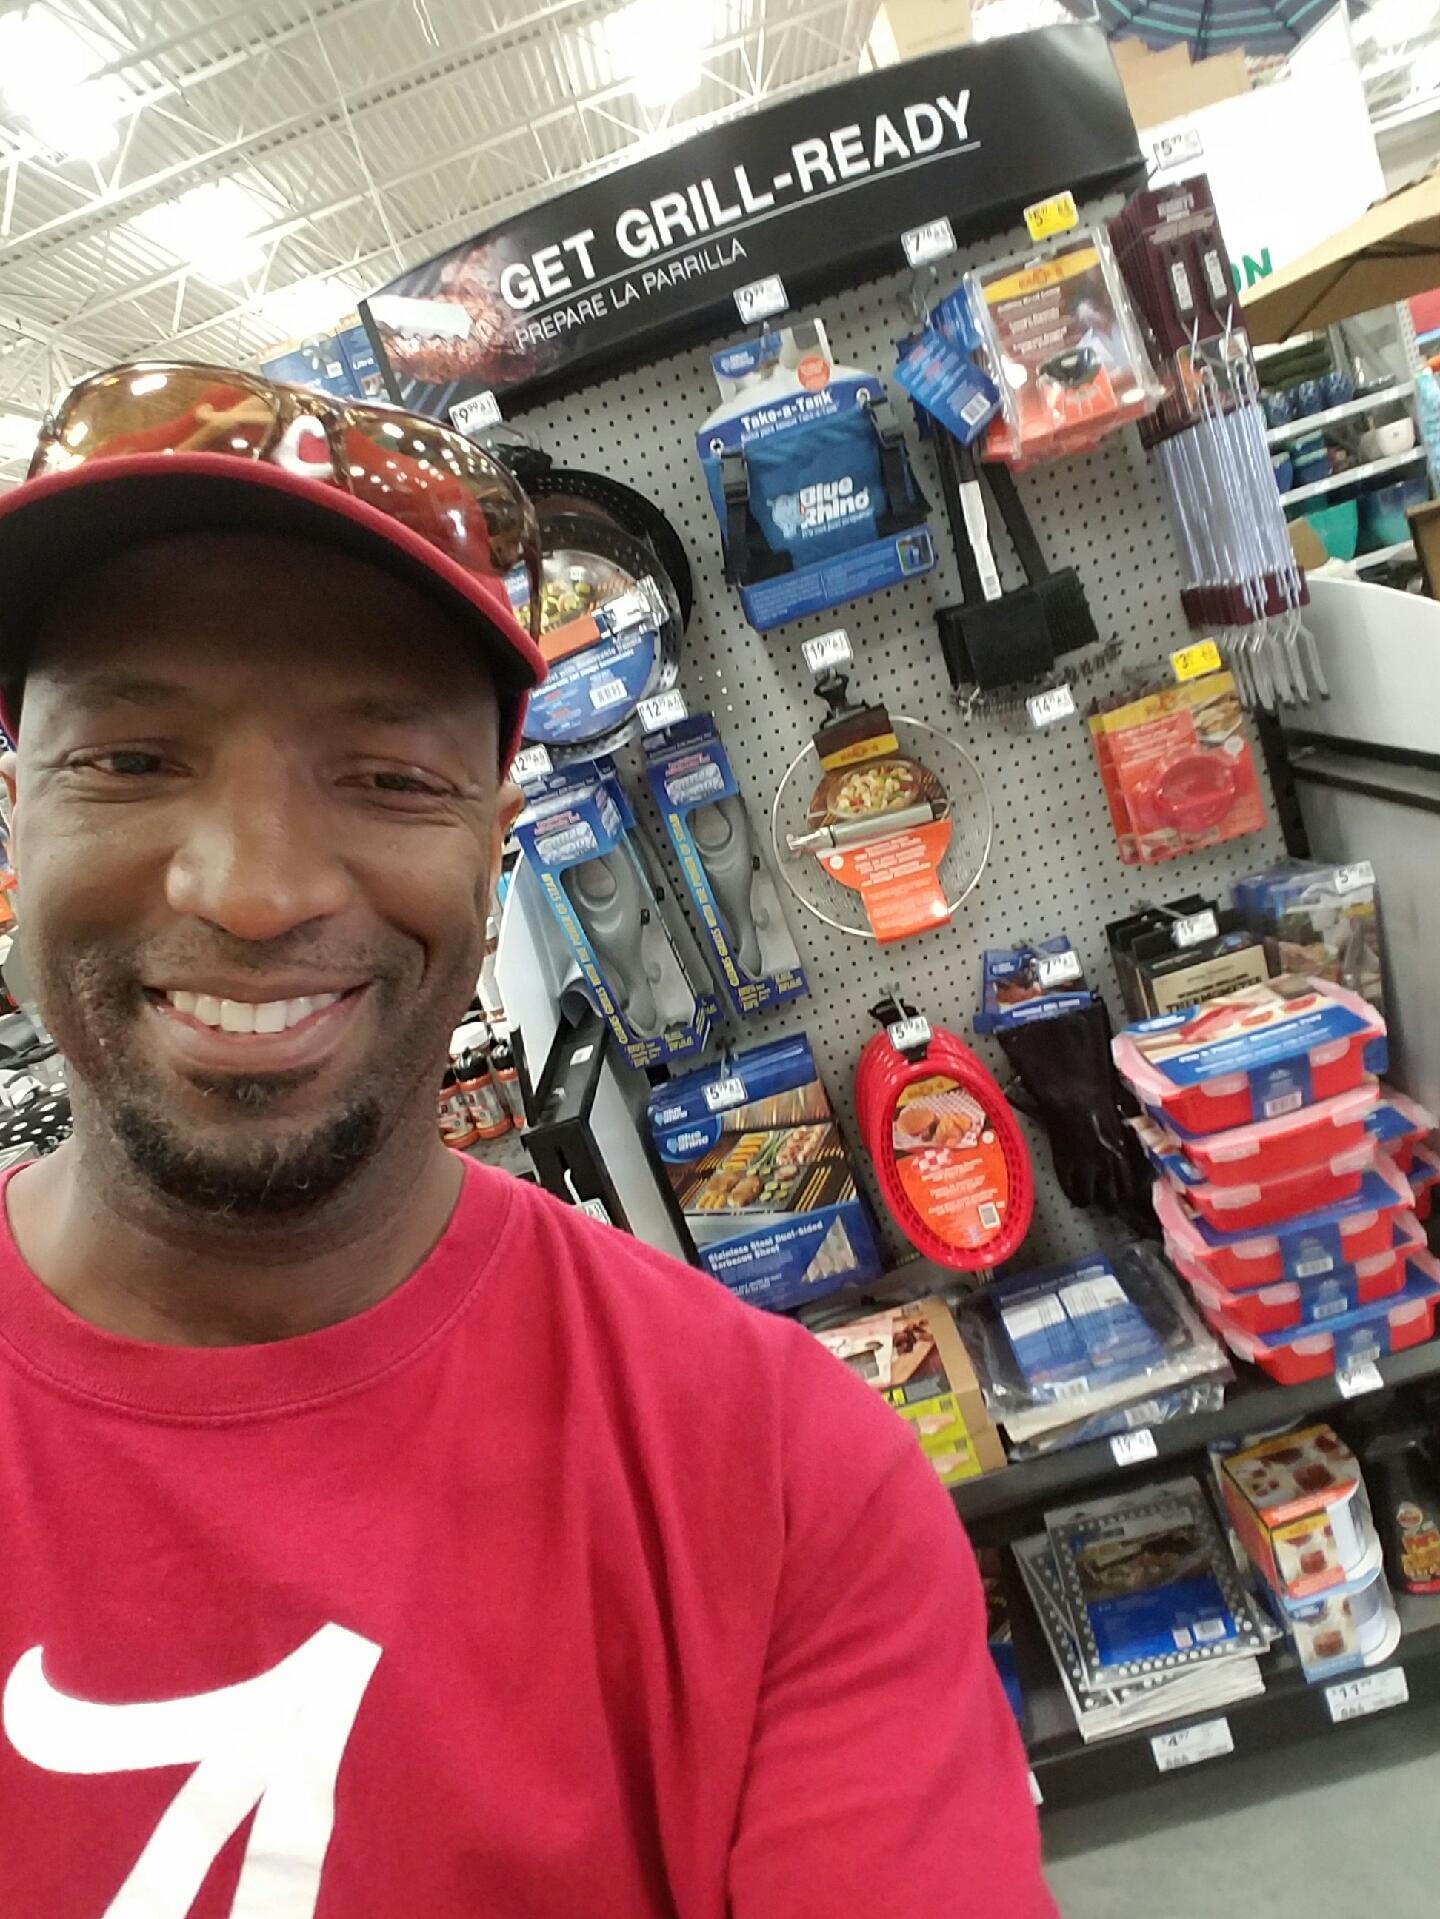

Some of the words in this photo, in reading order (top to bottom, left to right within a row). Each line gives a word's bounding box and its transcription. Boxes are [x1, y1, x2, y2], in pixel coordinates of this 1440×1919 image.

[499, 228, 597, 311] GET
[615, 89, 971, 259] GRILL-READY
[515, 294, 608, 351] PREPARE
[613, 281, 640, 310] LA
[643, 237, 748, 296] PARRILLA
